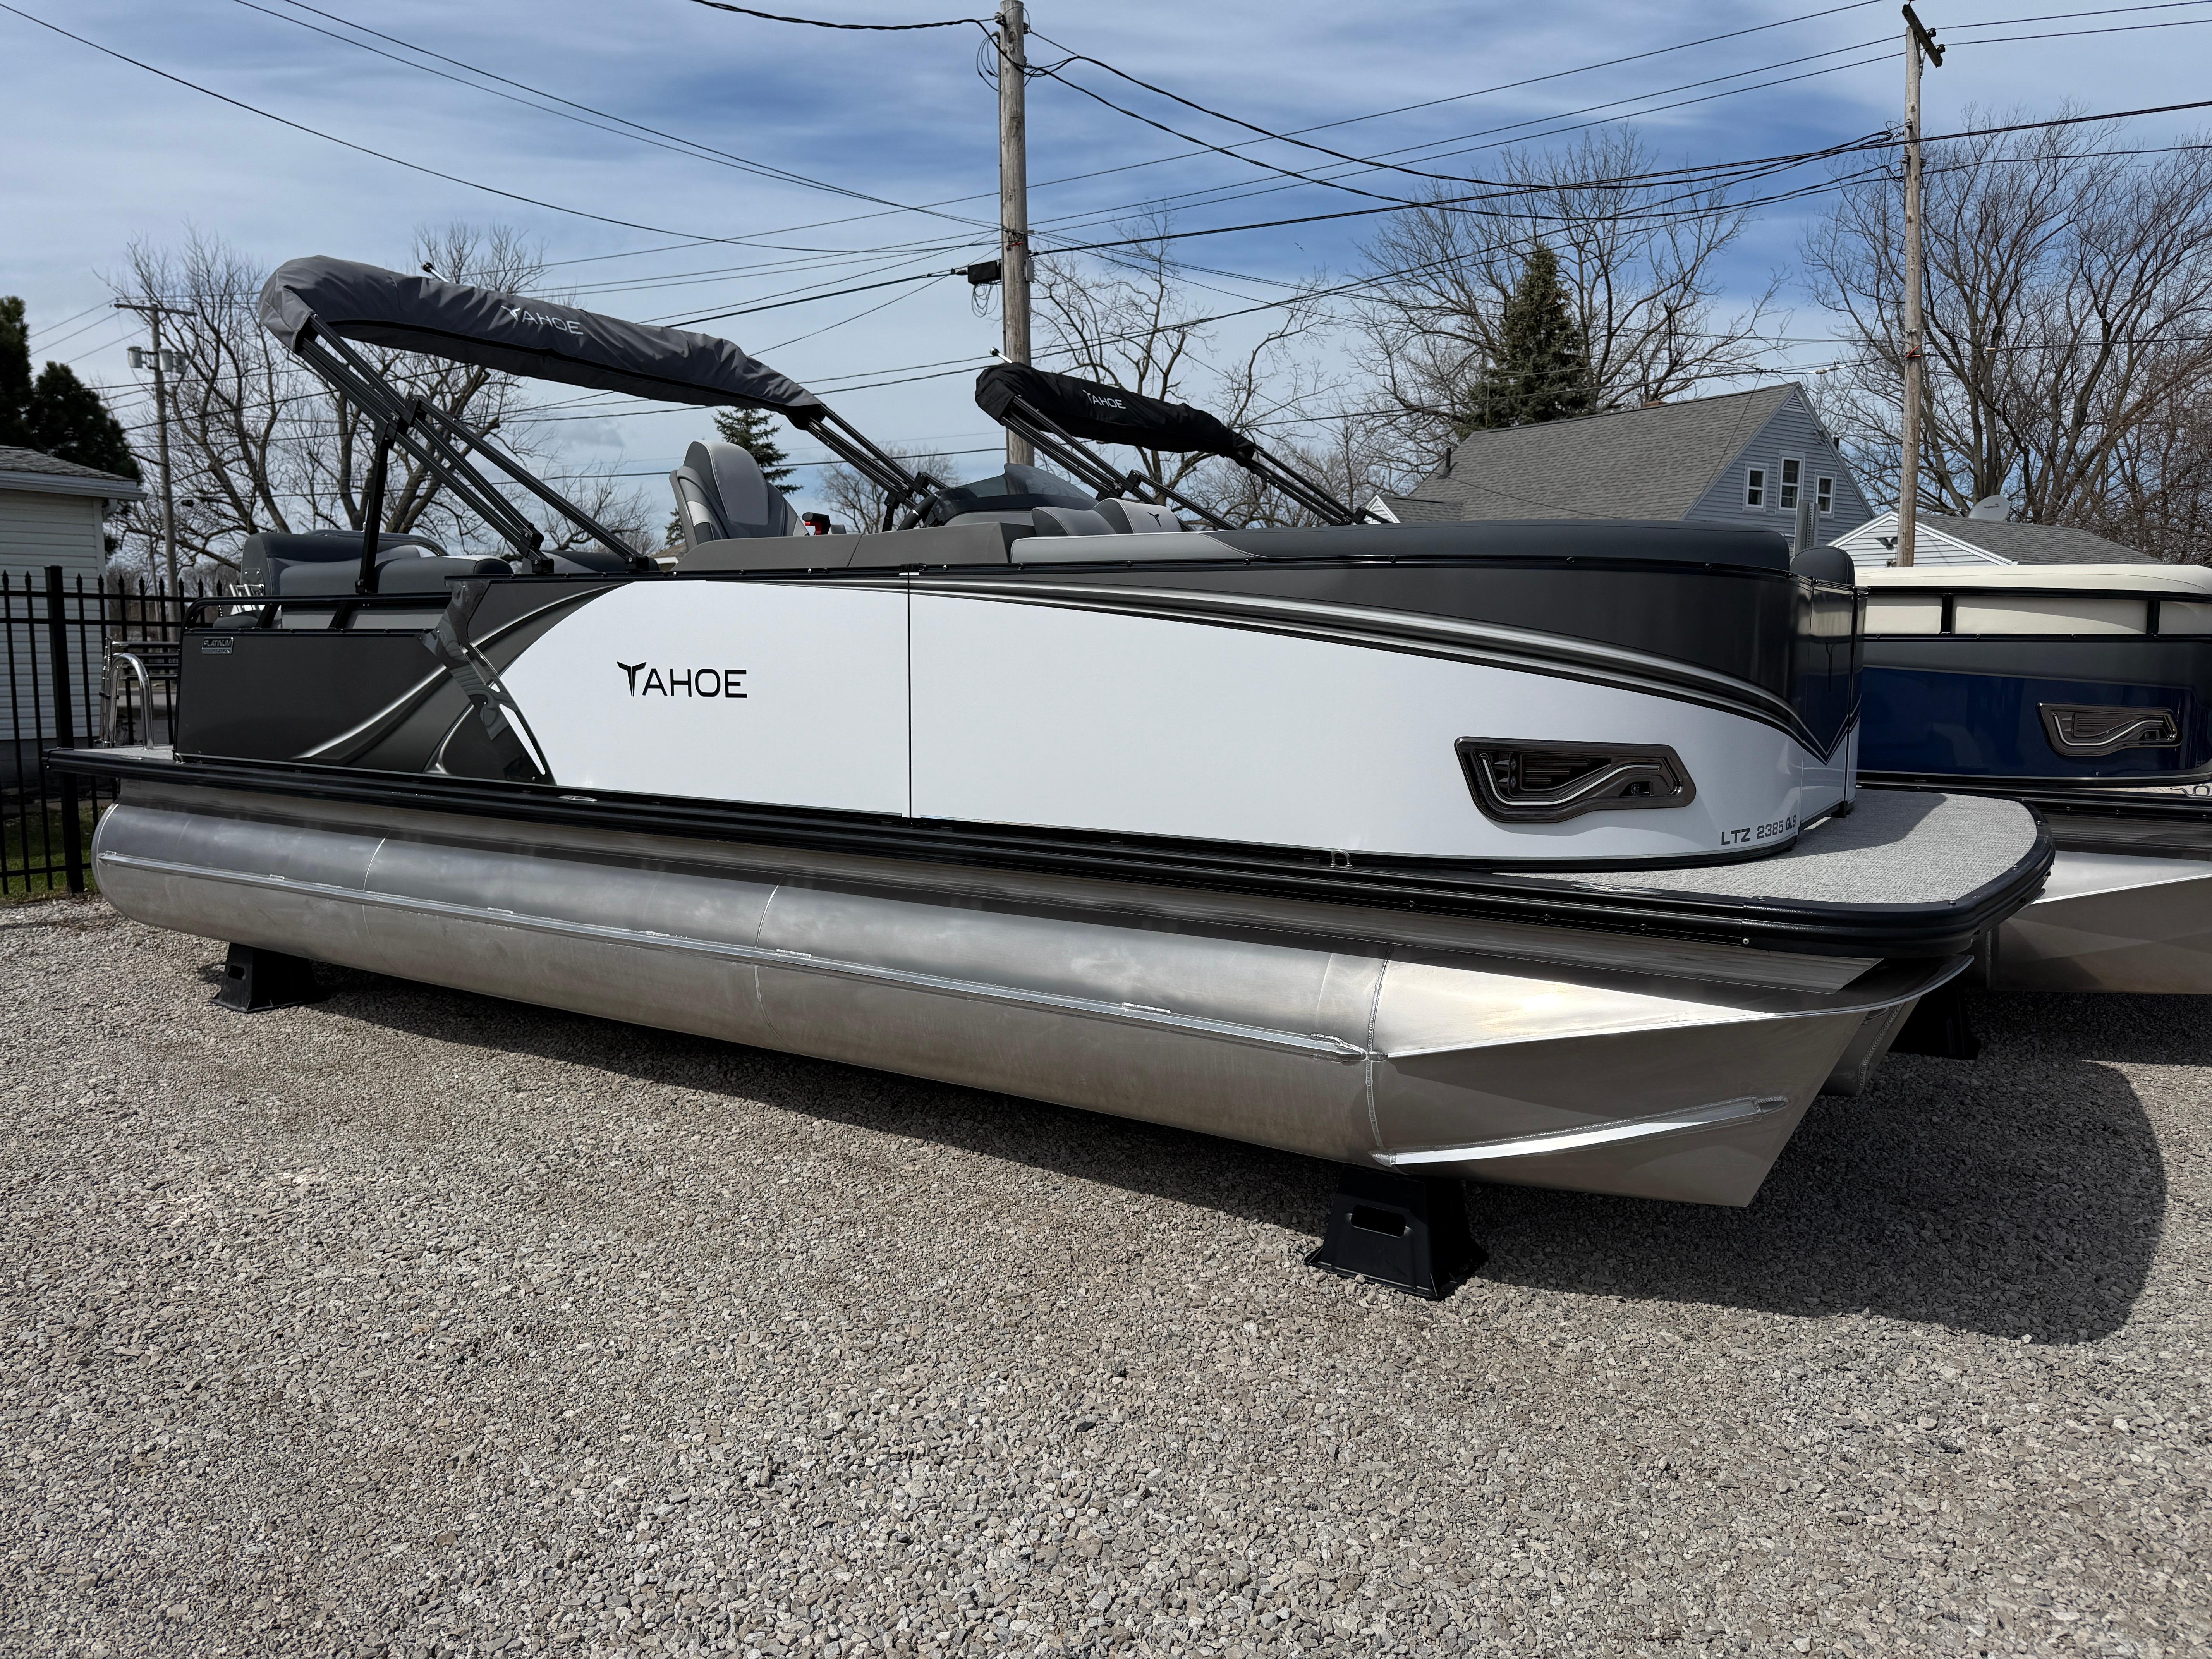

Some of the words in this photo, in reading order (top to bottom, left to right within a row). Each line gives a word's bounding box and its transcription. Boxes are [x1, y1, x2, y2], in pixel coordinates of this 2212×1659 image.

[501, 305, 584, 335] TAHOE
[1082, 389, 1127, 410] TAHOE
[616, 661, 748, 699] TAHOE
[1721, 828, 1750, 845] LTZ
[1757, 820, 1784, 839] 2385
